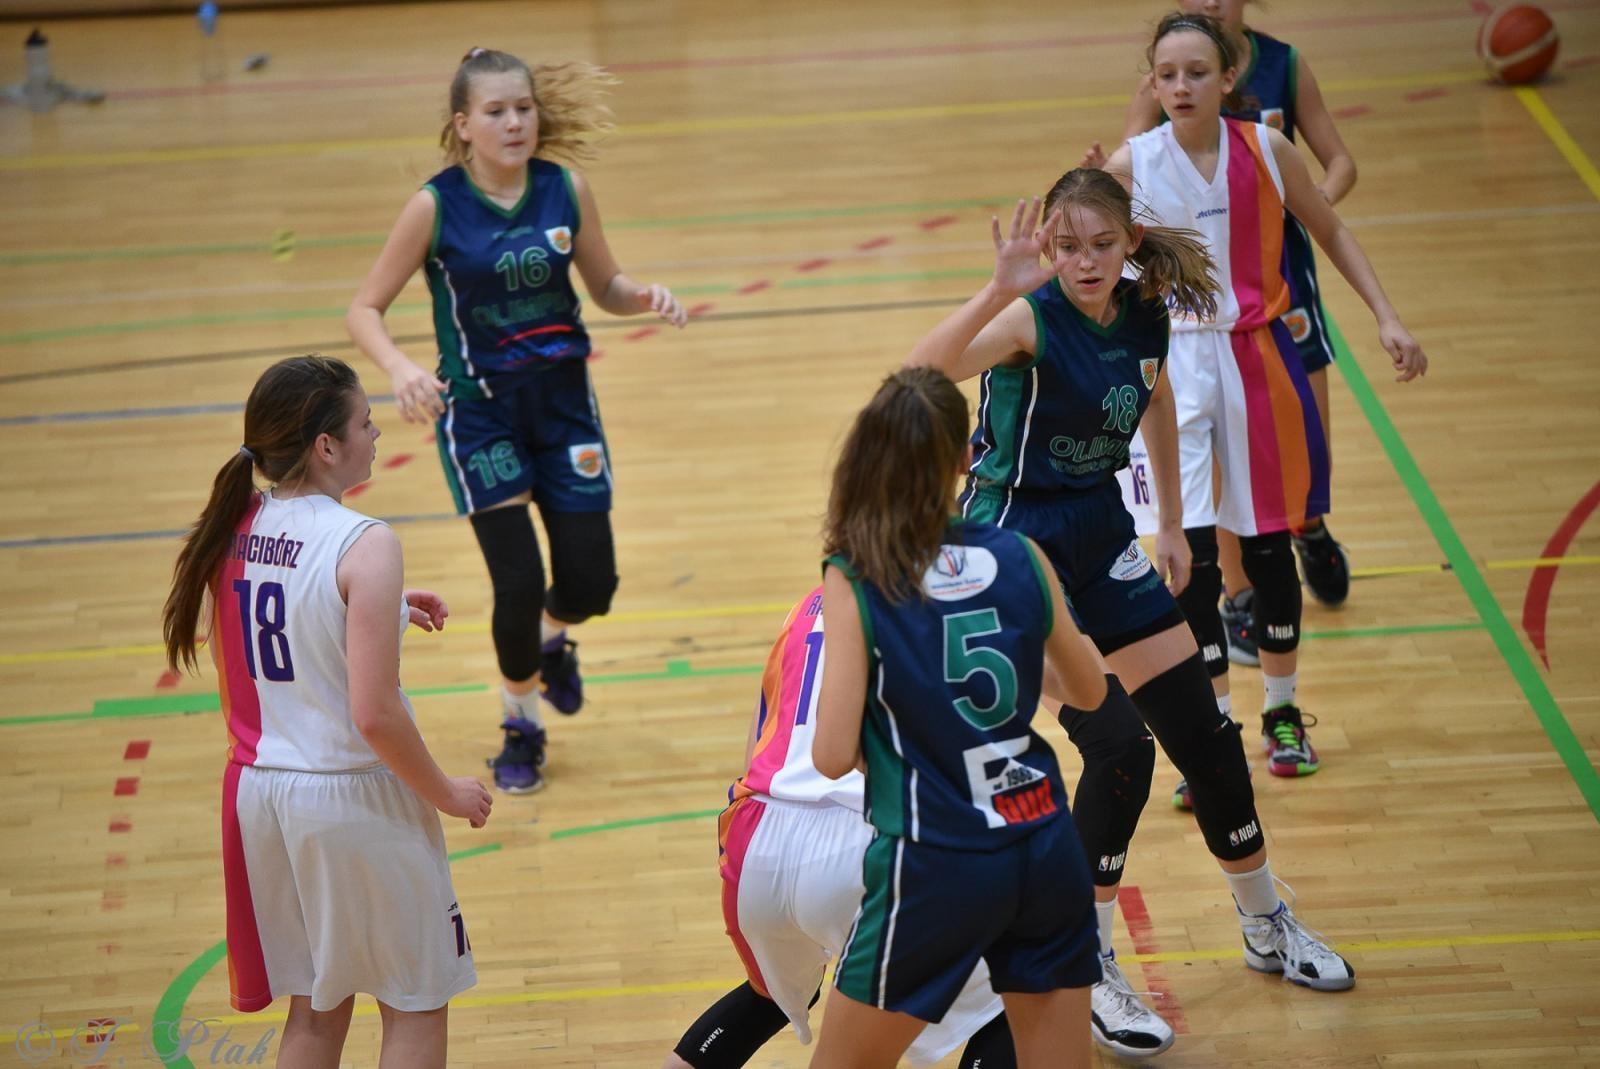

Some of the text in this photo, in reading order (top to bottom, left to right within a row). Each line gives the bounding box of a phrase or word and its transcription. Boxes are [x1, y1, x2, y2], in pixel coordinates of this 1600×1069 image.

[495, 246, 550, 292] 16
[1102, 384, 1139, 434] 18
[467, 440, 521, 490] 16
[232, 532, 304, 569] ACIBÓRZ
[233, 579, 295, 682] 18
[1275, 623, 1295, 640] NBA
[942, 607, 1018, 732] 5
[1202, 642, 1222, 662] NBA
[1238, 819, 1259, 843] NBA
[699, 1027, 725, 1054] TARMAK
